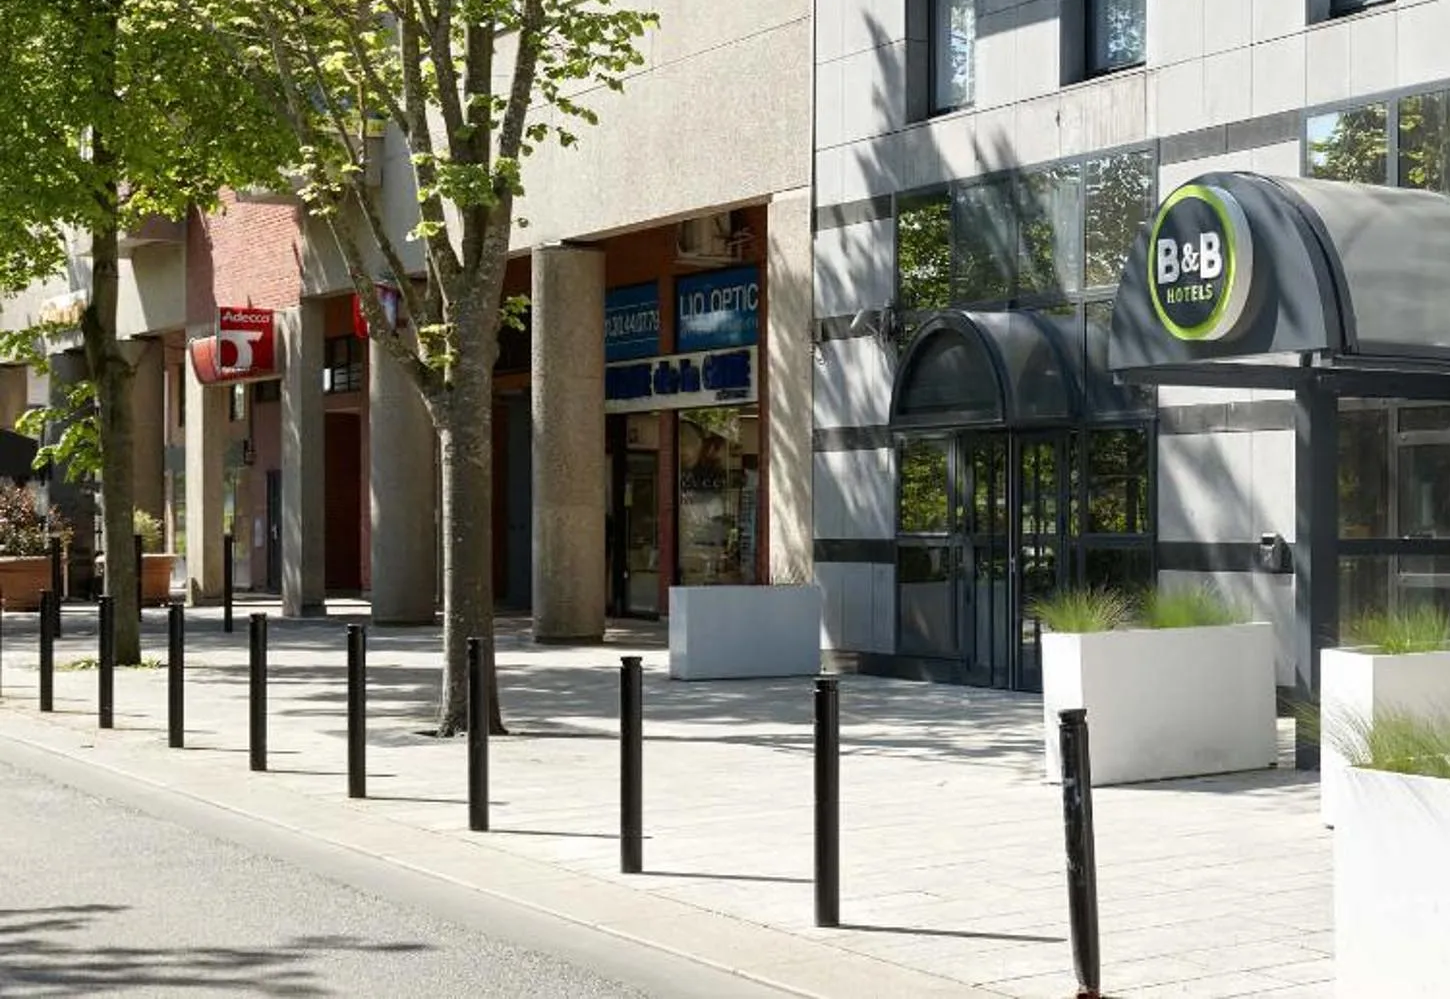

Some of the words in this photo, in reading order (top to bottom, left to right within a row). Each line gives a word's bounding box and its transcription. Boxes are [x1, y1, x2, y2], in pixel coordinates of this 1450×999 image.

[1157, 232, 1223, 284] B&B
[711, 283, 759, 313] OPTIC
[1166, 283, 1214, 304] HOTELS
[222, 311, 270, 323] Adecco
